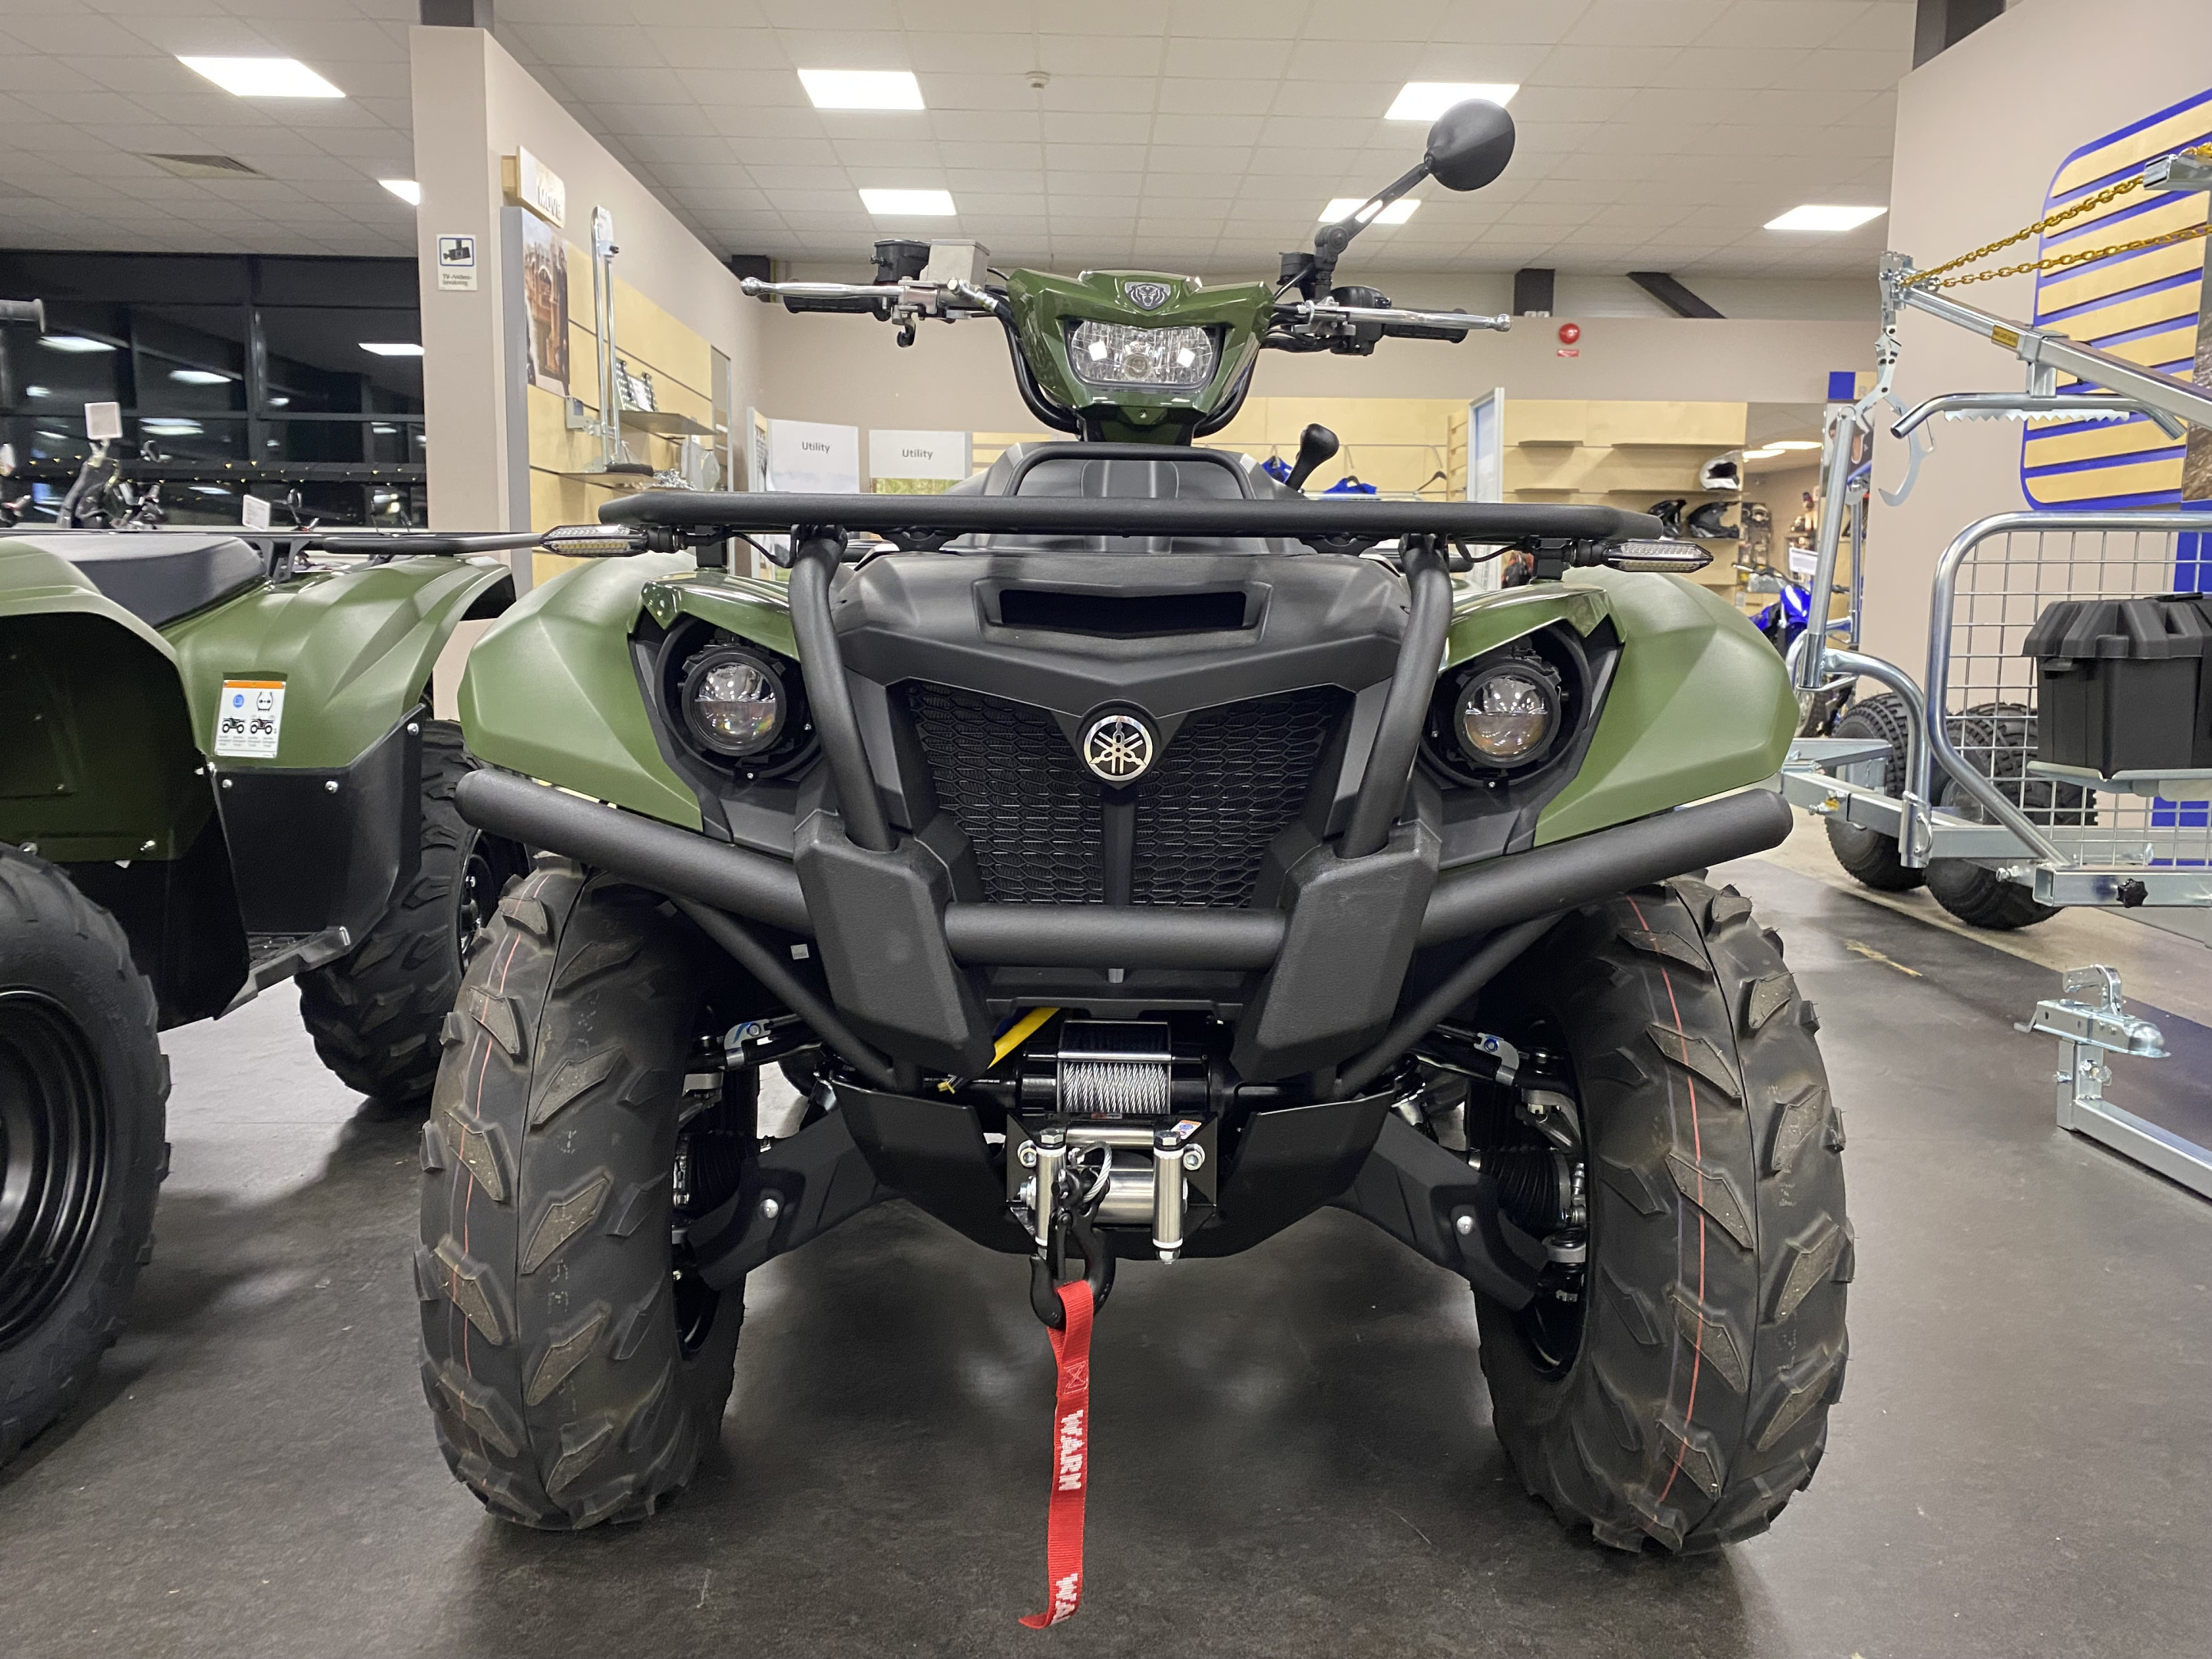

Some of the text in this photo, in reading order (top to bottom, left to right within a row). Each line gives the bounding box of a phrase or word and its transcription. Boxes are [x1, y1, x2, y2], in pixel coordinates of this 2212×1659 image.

[538, 184, 562, 222] MOVE
[802, 441, 830, 454] Utility
[902, 449, 933, 460] Utility
[1058, 1409, 1084, 1491] WARN
